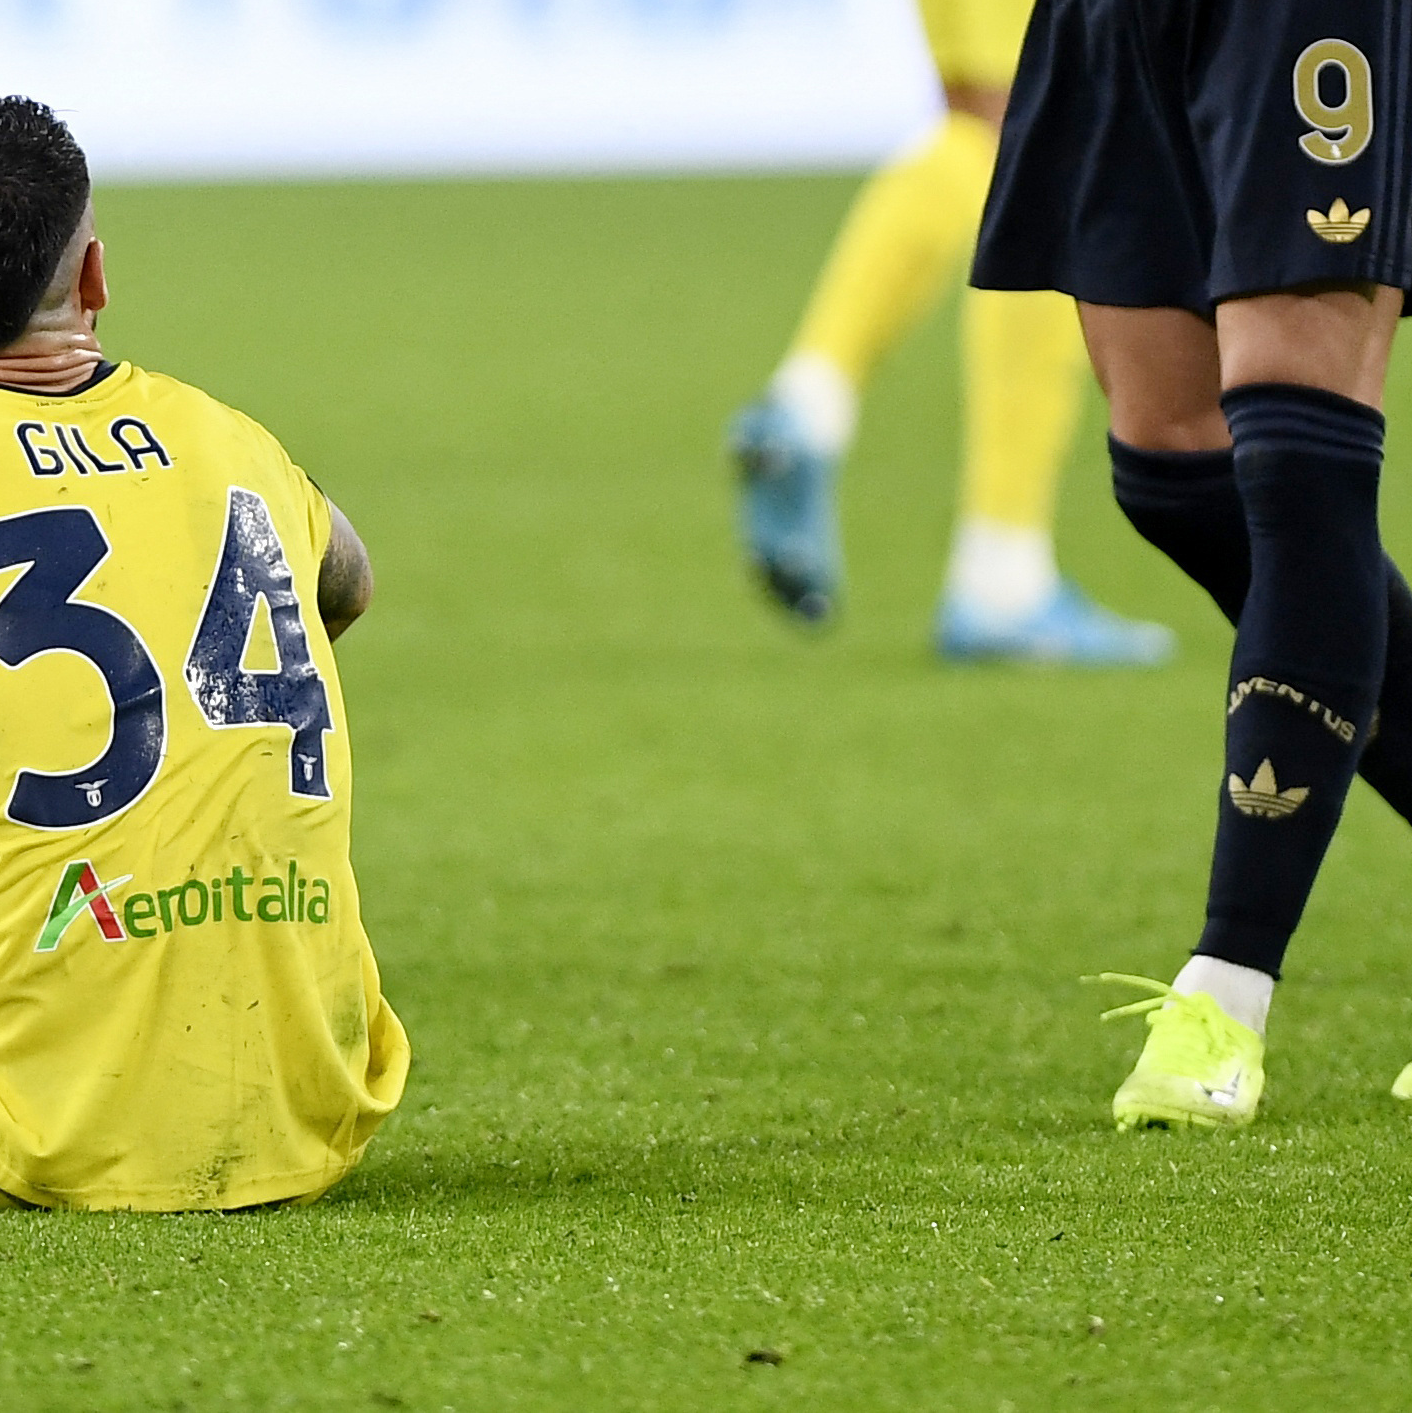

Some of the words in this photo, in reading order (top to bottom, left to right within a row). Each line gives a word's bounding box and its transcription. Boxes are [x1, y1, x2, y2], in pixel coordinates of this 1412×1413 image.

[1292, 37, 1374, 166] 9
[15, 415, 174, 478] GILA
[33, 858, 333, 953] Aeroitalia
